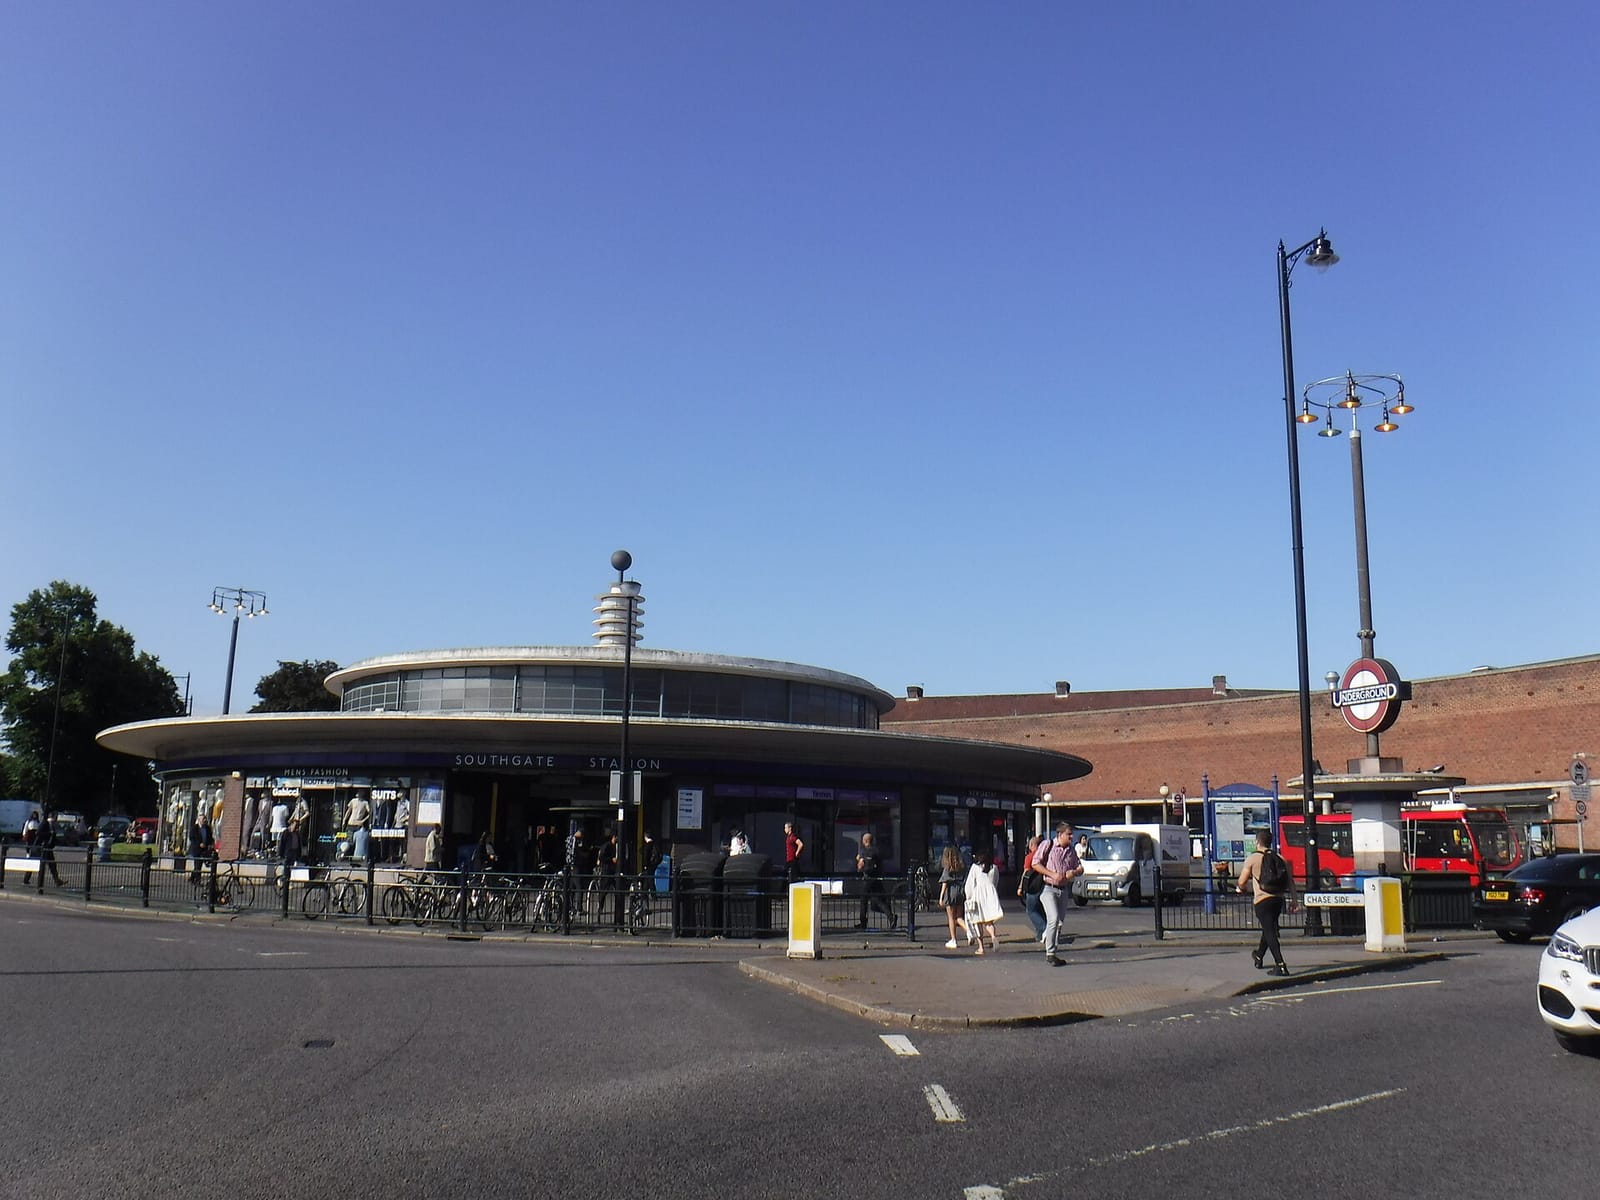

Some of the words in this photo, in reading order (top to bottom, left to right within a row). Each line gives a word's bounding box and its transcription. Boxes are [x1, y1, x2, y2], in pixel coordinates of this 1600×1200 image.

[1332, 683, 1397, 707] UNDERGROUND
[455, 755, 554, 767] SOUTHGATE
[589, 757, 661, 770] STAION
[284, 768, 306, 776] MENS
[310, 768, 349, 776] FASHION
[371, 789, 397, 800] SUITS
[1307, 896, 1331, 904] CHASE
[1334, 895, 1350, 904] SIDE
